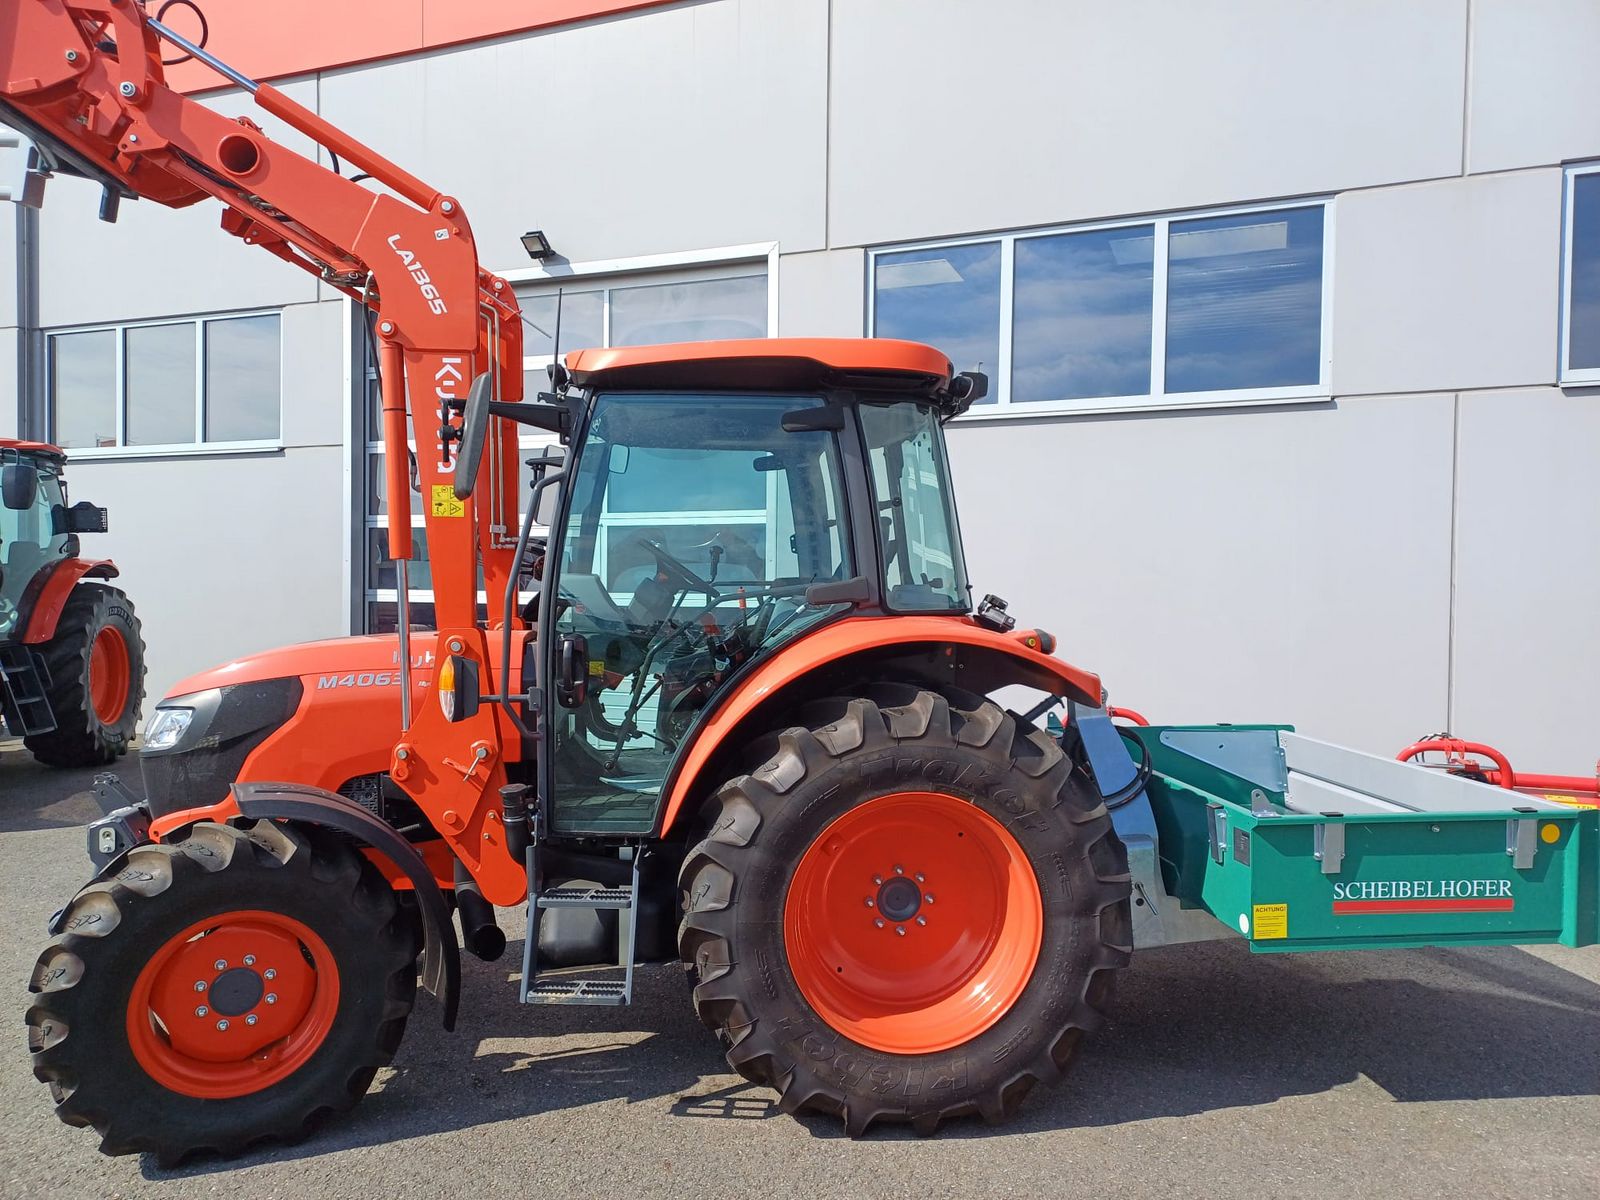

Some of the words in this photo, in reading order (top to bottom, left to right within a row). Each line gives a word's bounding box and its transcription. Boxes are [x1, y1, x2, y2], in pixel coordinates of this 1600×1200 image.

[387, 233, 448, 315] LA1365
[435, 357, 462, 474] Kuta
[1333, 879, 1513, 901] SCHEIBELHOFER
